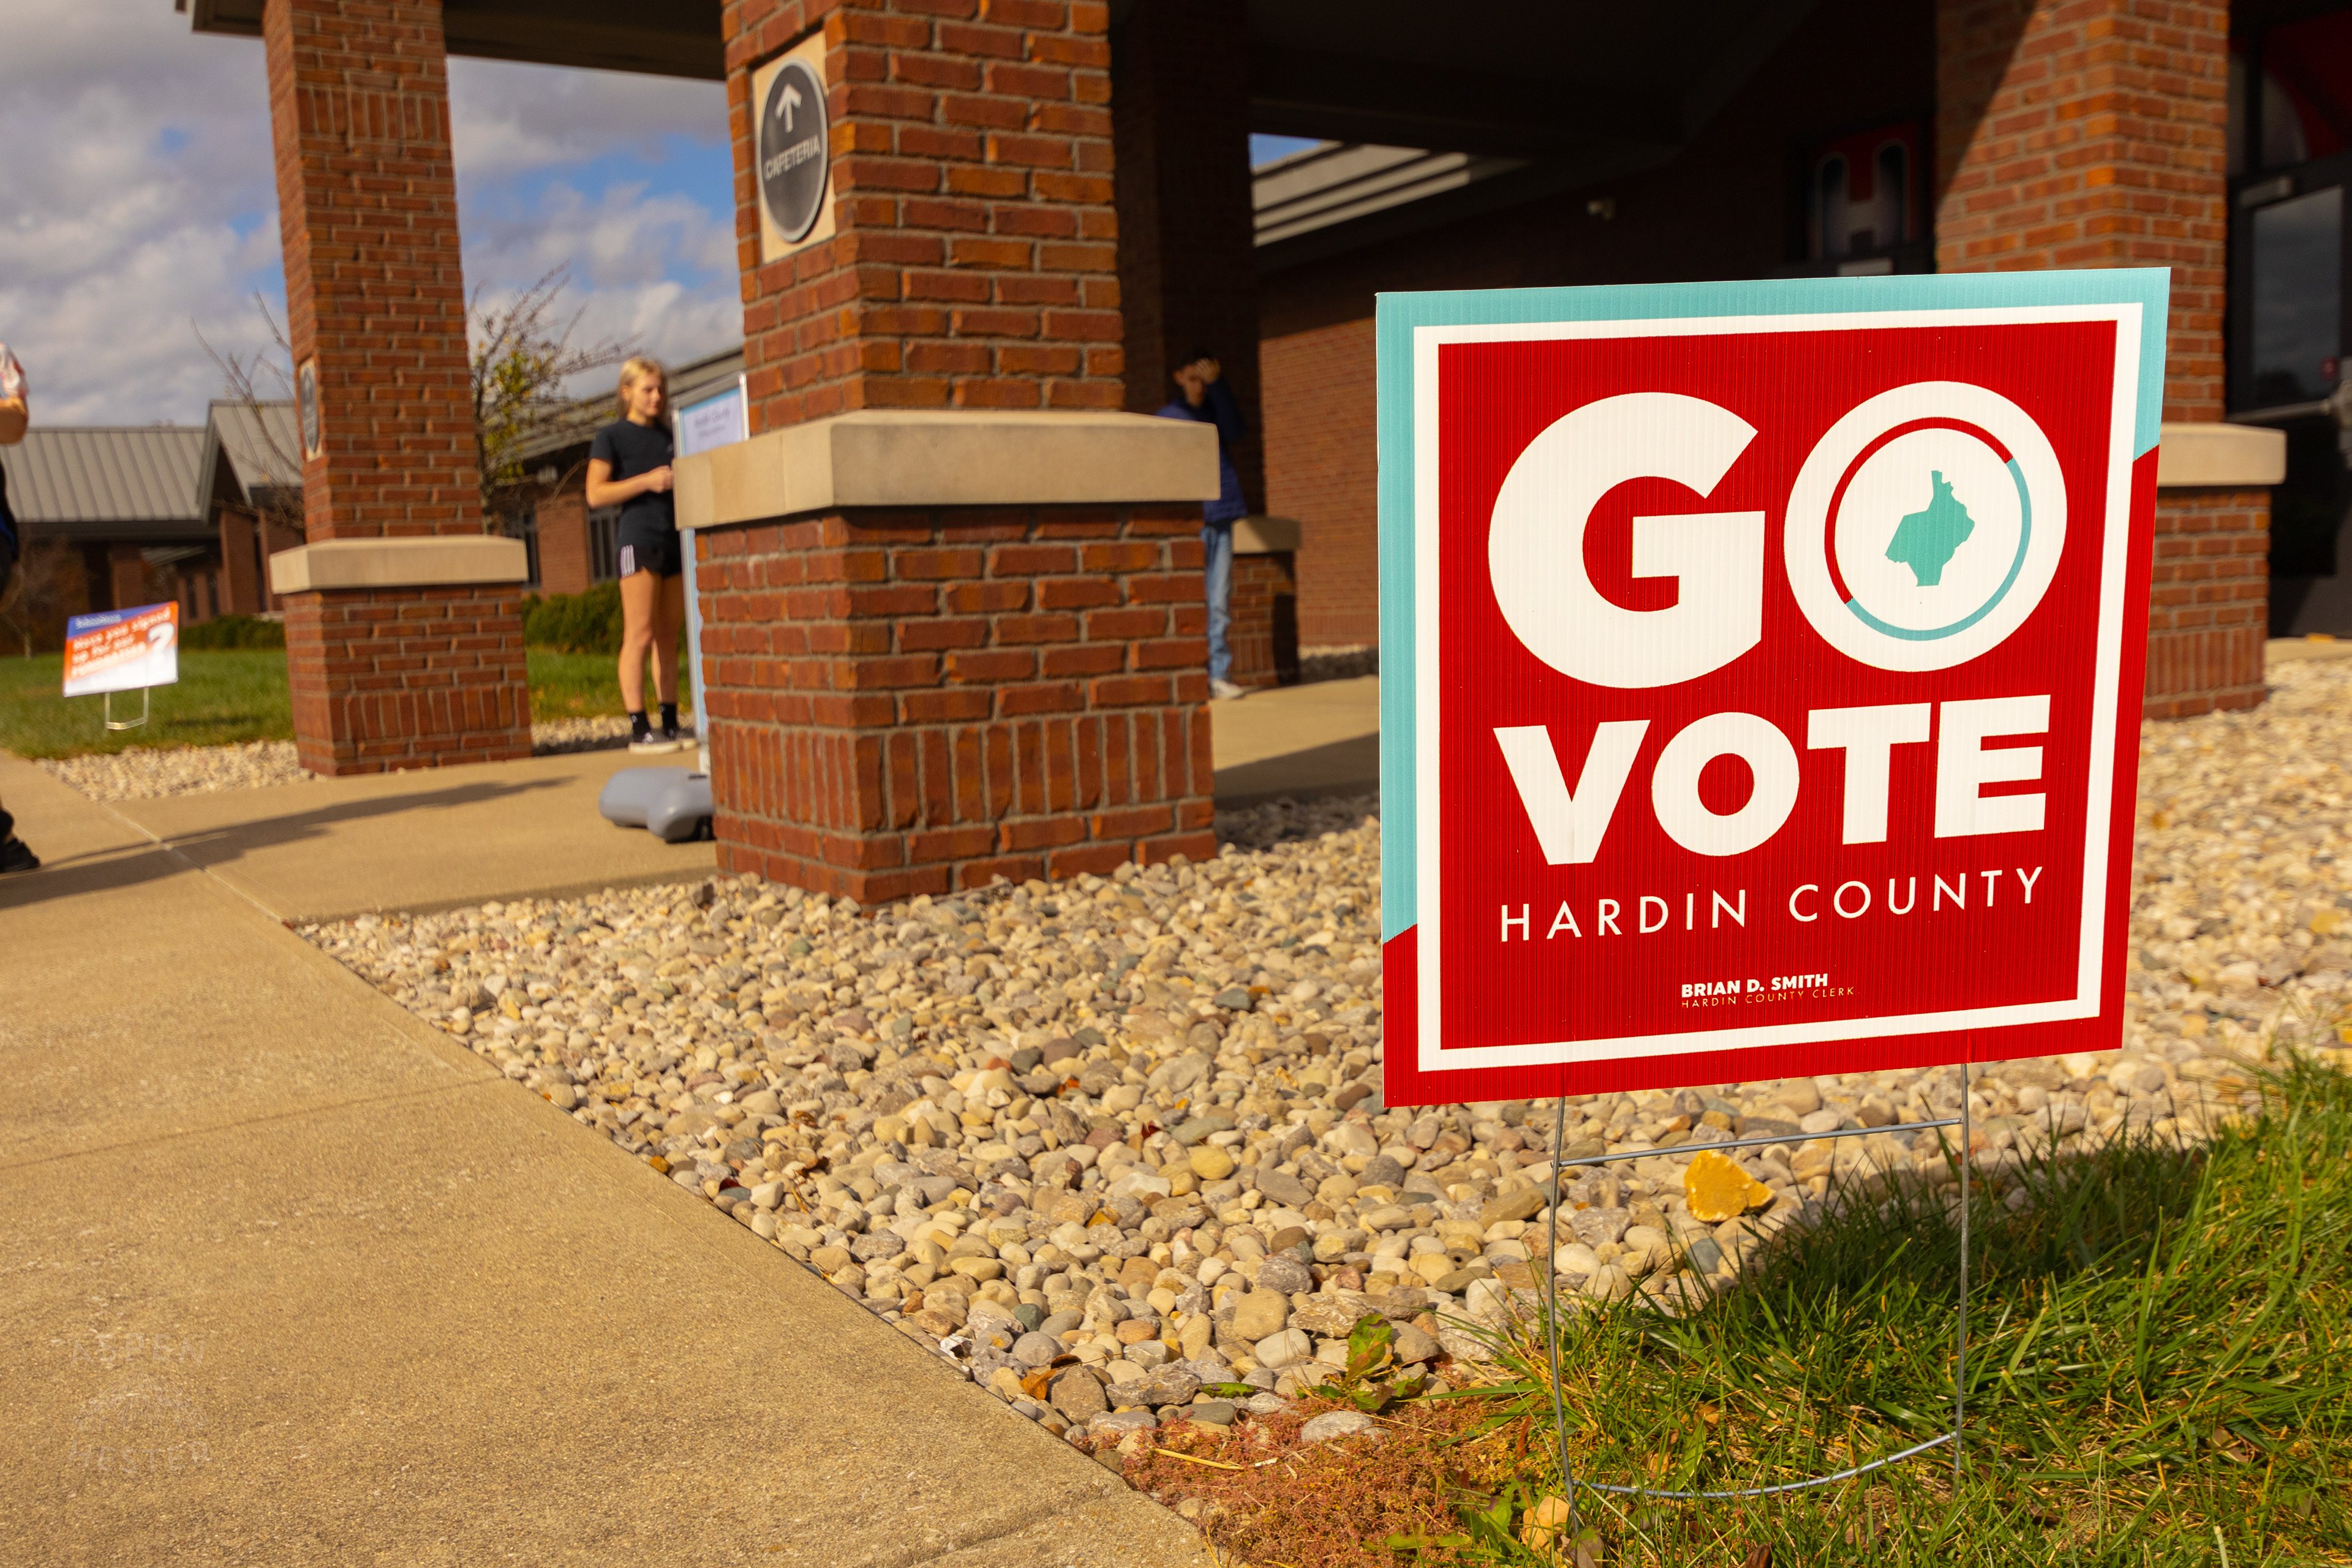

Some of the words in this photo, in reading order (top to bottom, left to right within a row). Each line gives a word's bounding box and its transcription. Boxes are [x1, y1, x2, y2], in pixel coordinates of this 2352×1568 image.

[764, 135, 821, 181] CAFETERIA
[1488, 381, 2067, 688] GO
[1493, 695, 2051, 865] VOTE
[1502, 890, 1745, 941] HARDIN
[1789, 867, 2042, 922] COUNTY
[1681, 997, 1736, 1008] HARDIN
[1746, 990, 1804, 1003] COUNTY
[1812, 987, 1854, 998] CLERK
[1682, 979, 1740, 997] BRIAN
[1747, 979, 1764, 992] D.
[1771, 973, 1828, 990] SMITH
